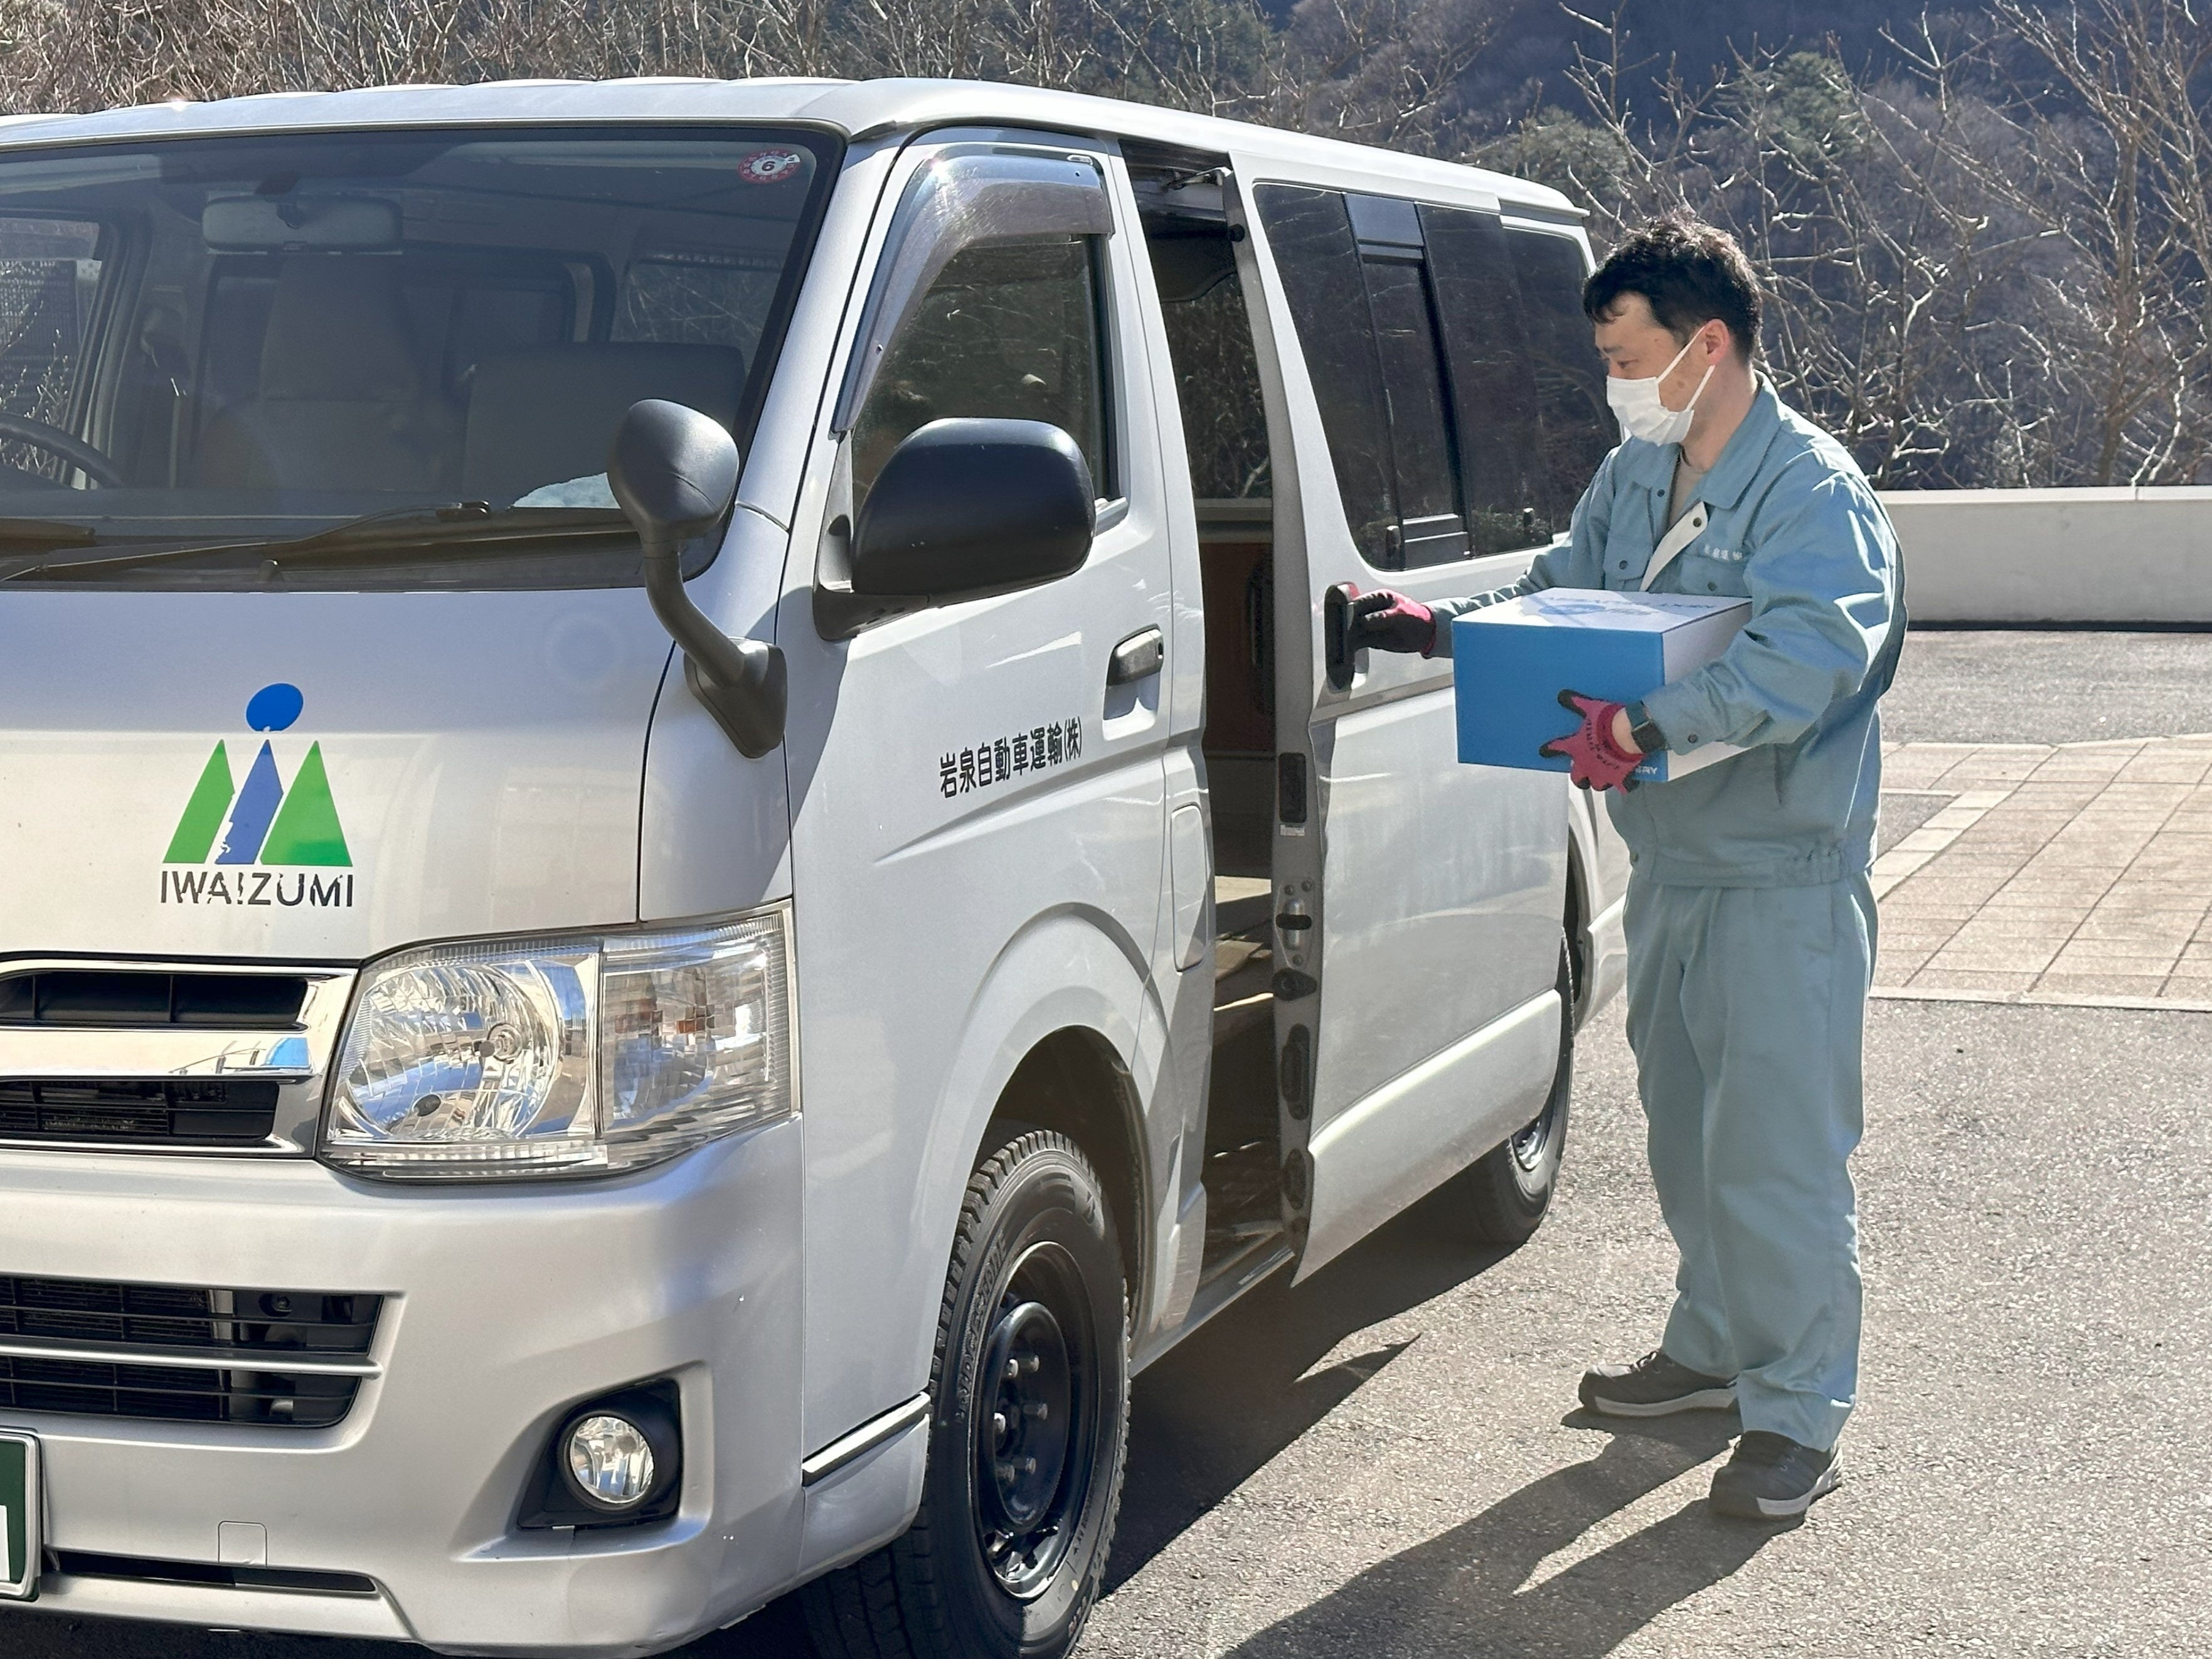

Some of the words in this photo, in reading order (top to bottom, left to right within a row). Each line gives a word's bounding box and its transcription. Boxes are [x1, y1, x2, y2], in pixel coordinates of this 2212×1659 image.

[761, 161, 775, 171] 6
[940, 716, 1082, 798] 岩泉自動車運輸(株)
[161, 871, 353, 907] IWAIZUMI
